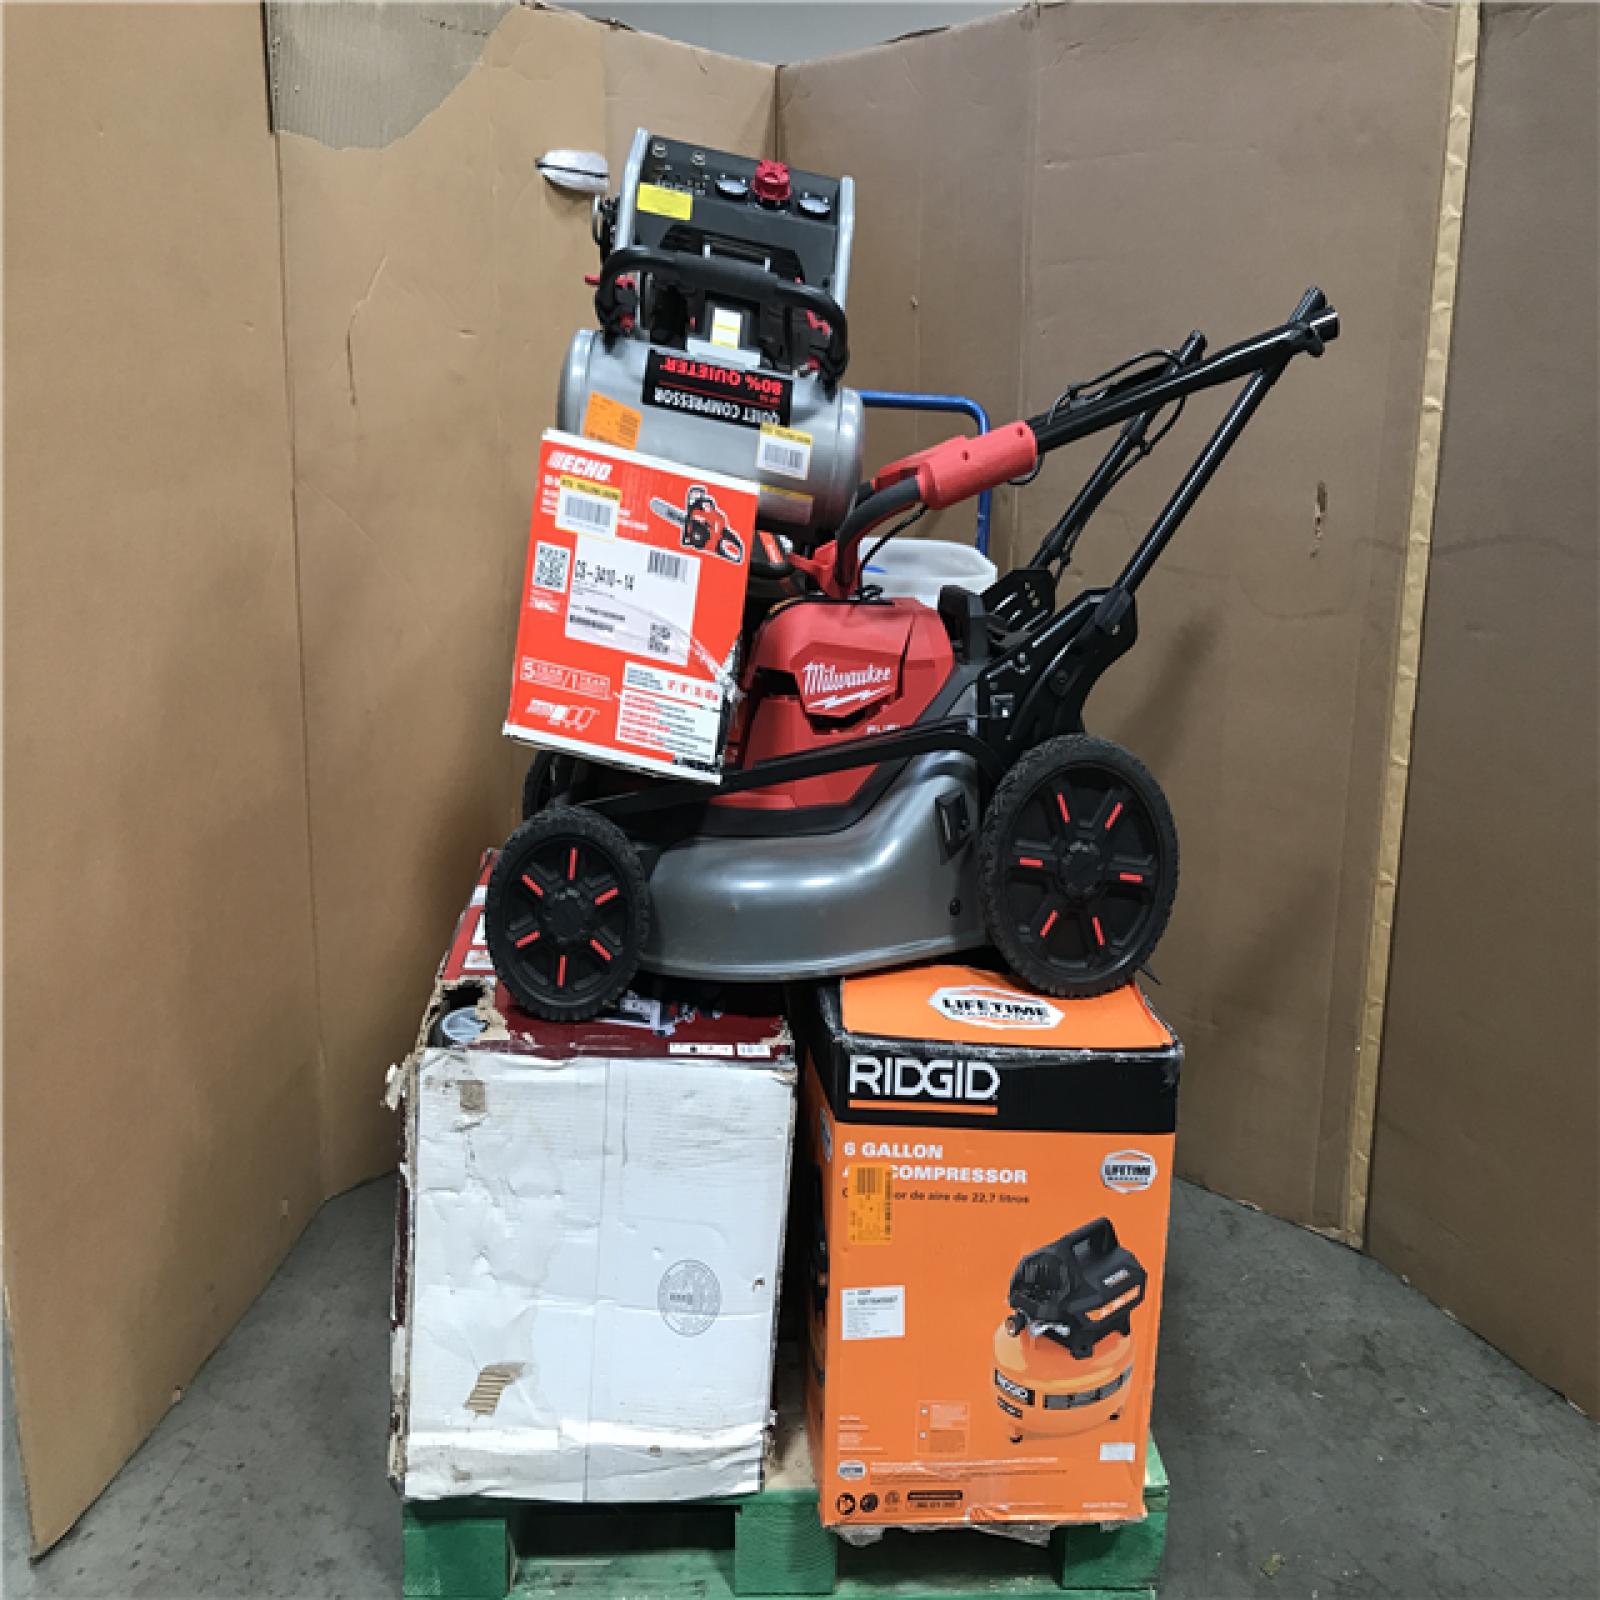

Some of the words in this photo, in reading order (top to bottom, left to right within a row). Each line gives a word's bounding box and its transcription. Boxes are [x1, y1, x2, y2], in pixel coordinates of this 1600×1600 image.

[654, 387, 741, 419] COMPRESSOR
[561, 454, 613, 481] ECHO
[802, 661, 891, 696] Milwaukee
[942, 998, 1050, 1017] LIFETIME
[849, 1054, 1001, 1099] RIDGID
[861, 1142, 944, 1160] GALLON
[1104, 1164, 1151, 1176] LIFETIME
